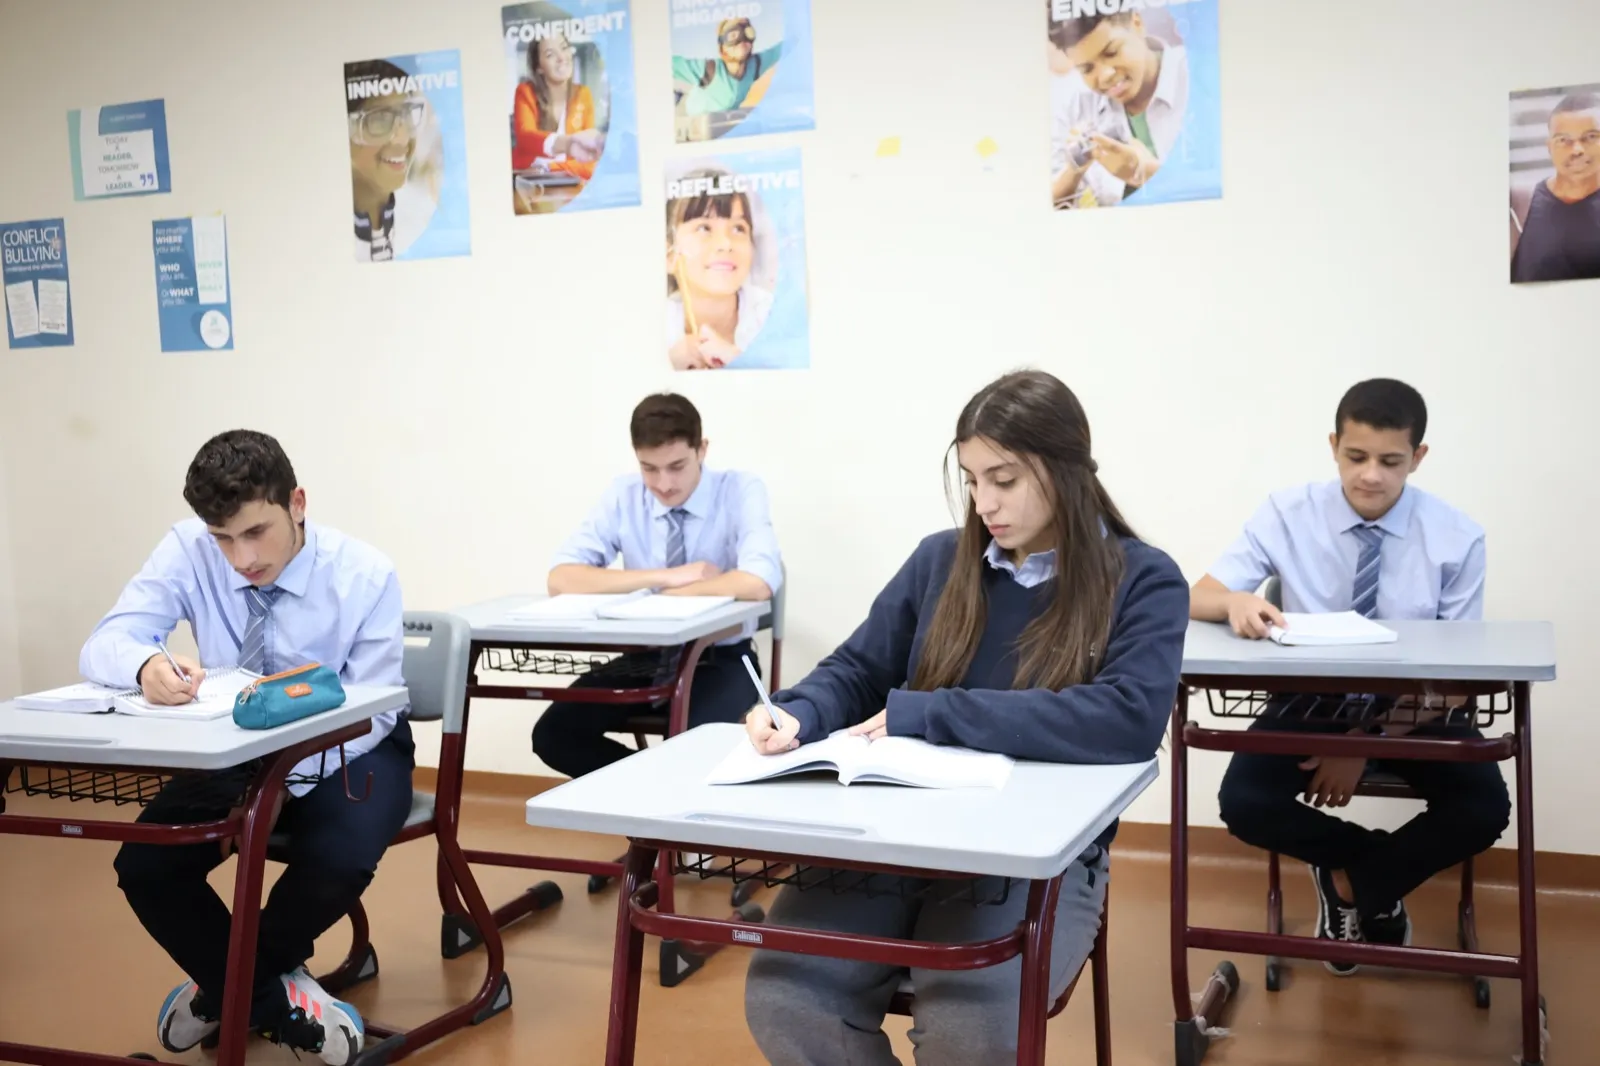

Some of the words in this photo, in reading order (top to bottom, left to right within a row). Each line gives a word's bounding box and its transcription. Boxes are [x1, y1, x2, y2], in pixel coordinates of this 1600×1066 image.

[505, 10, 626, 42] CONFIDENT
[346, 70, 458, 100] INNOVATIVE
[667, 169, 799, 200] REFLECTIVE
[3, 226, 60, 247] CONFLICT
[156, 235, 182, 245] WHERE
[5, 245, 61, 264] BULLYING
[160, 261, 180, 272] WHO
[169, 287, 194, 297] WHAT
